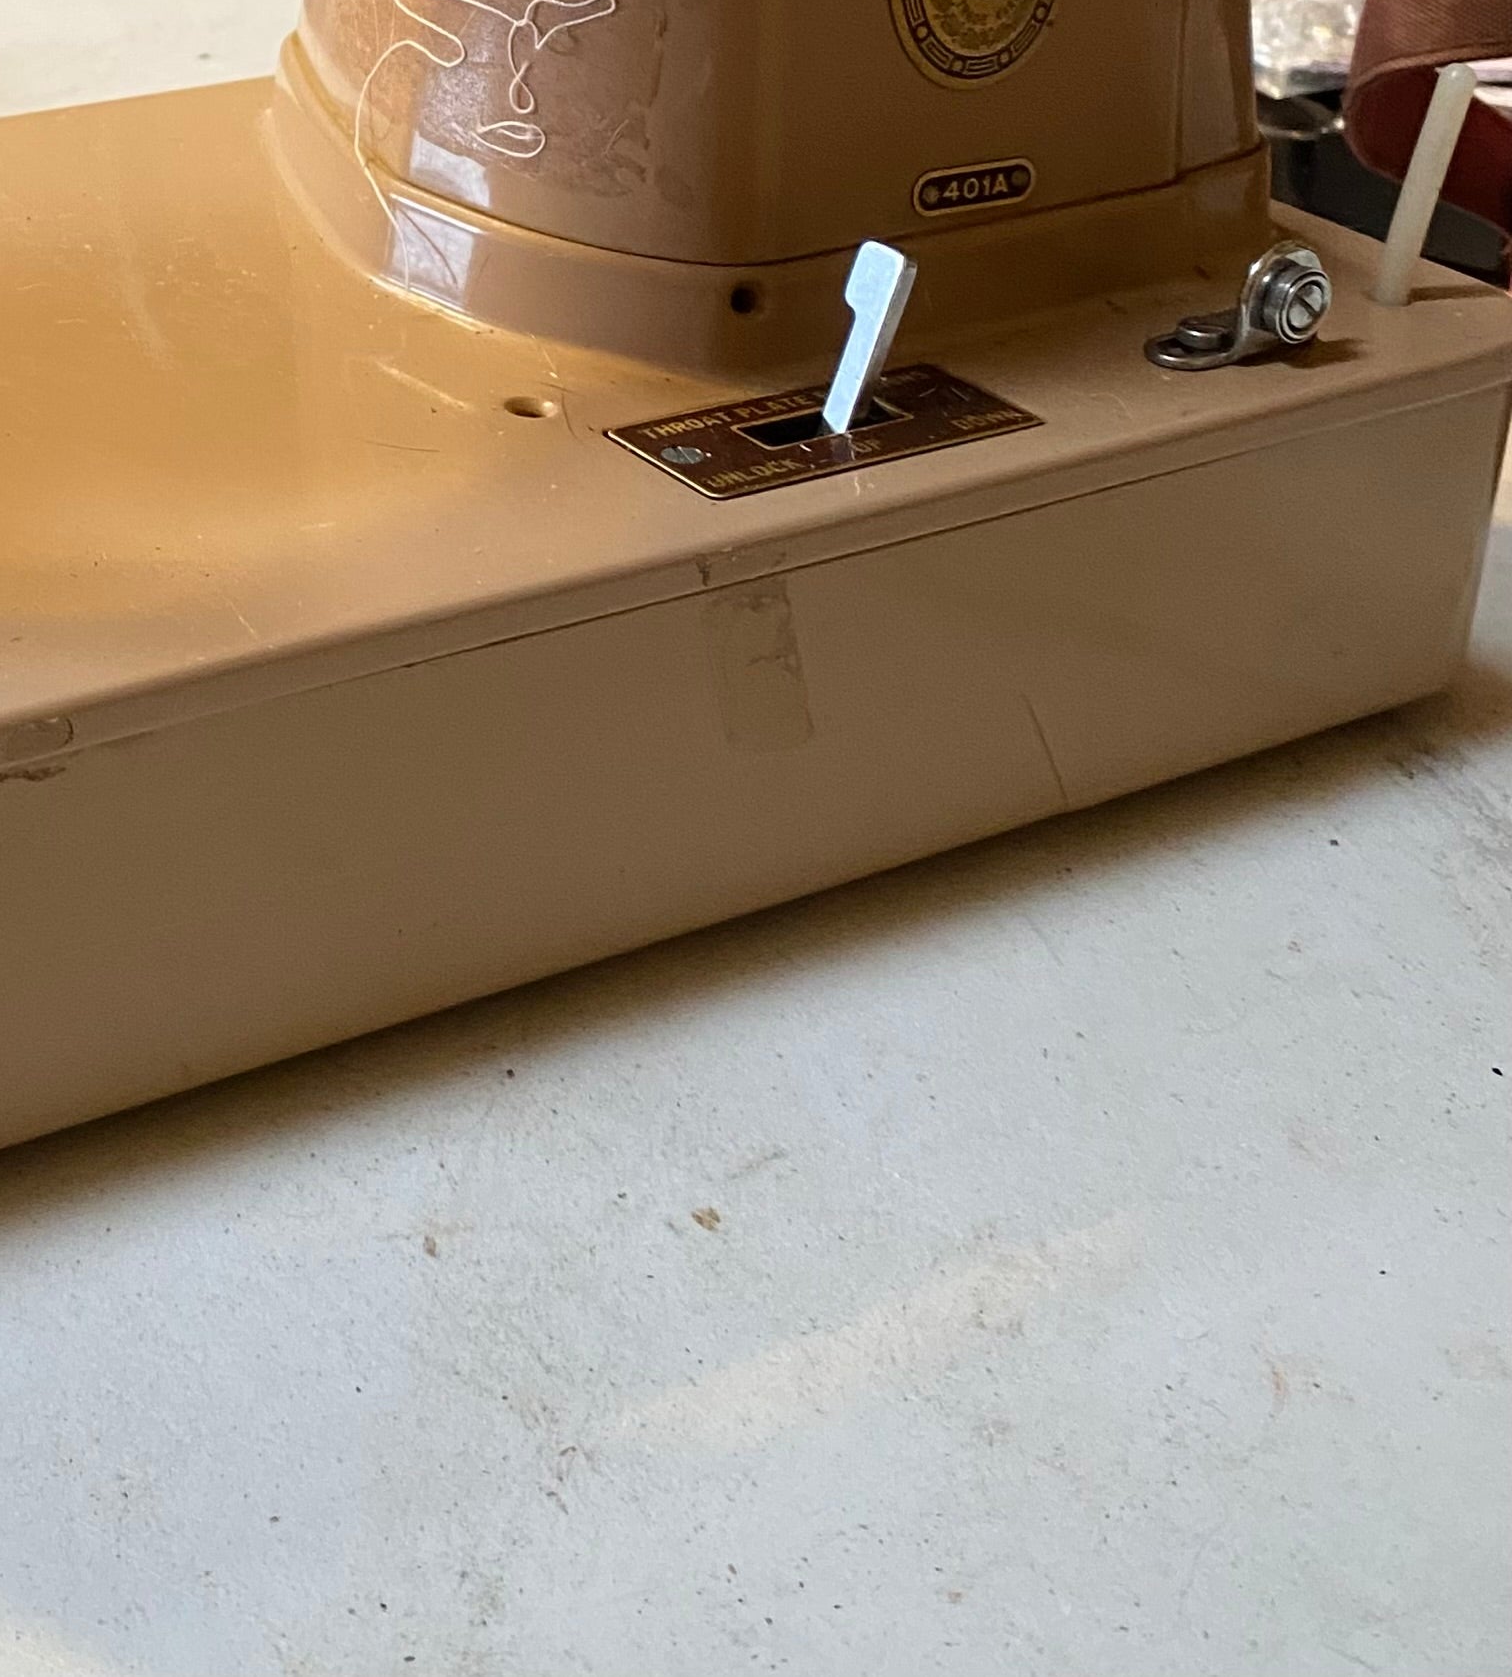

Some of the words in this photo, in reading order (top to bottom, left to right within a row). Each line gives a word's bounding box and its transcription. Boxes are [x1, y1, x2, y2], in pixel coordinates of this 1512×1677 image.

[942, 173, 1008, 201] 401A
[641, 411, 732, 440] THROAT
[734, 393, 813, 419] PLATE
[705, 458, 805, 488] UNLOCK
